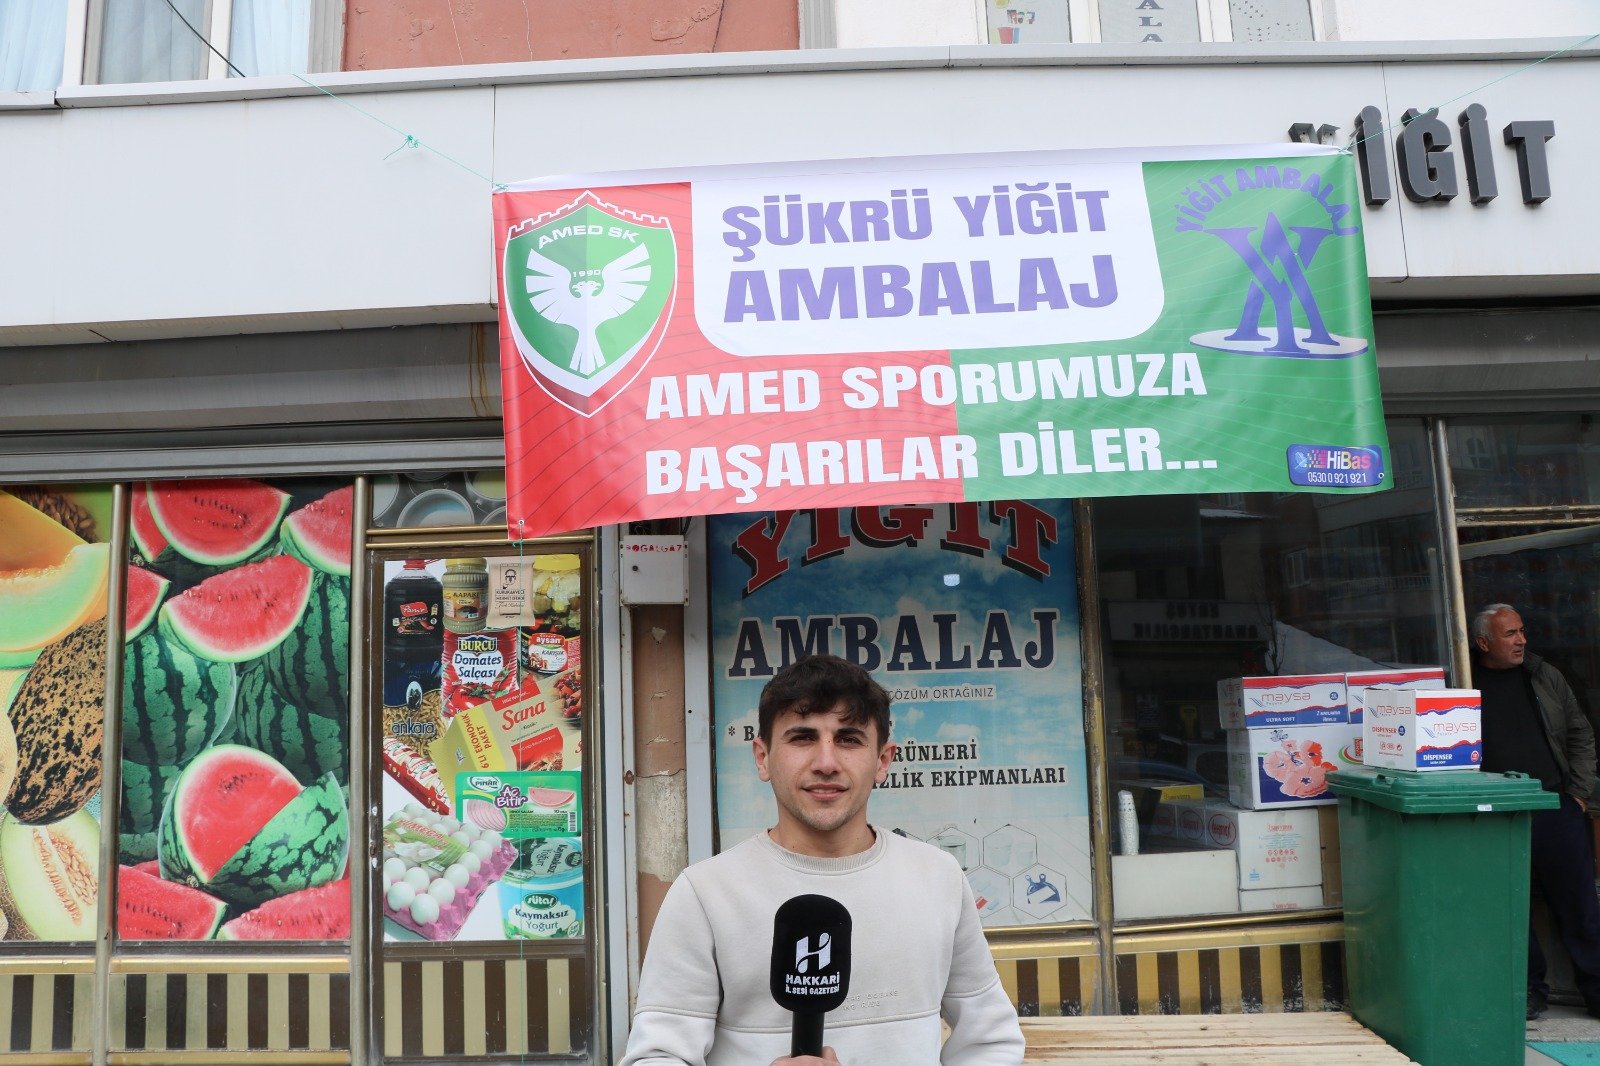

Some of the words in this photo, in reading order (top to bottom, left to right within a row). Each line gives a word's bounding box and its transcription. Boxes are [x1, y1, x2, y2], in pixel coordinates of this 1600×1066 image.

[1175, 174, 1233, 233] YİĞİT
[1235, 165, 1359, 236] AMBALAJ
[722, 188, 933, 263] ŞÜKRÜ
[952, 181, 1110, 238] YİĞİT
[538, 225, 603, 250] AMED
[608, 226, 640, 244] SK
[572, 269, 602, 278] 1990
[723, 254, 1119, 323] AMBALAJ
[645, 369, 821, 420] AMED
[841, 352, 1207, 409] SPORUMUZA
[645, 434, 979, 504] BAŞARILAR
[999, 421, 1218, 477] DİLER...
[1327, 450, 1372, 470] HiBas
[460, 640, 495, 651] BURCU
[536, 635, 562, 644] aysan
[728, 610, 1057, 678] AMBALAJ
[454, 653, 502, 666] Domates
[458, 666, 497, 680] Salçası
[933, 686, 994, 698] ORTAĞINIZ
[1261, 692, 1311, 703] maysa
[502, 700, 547, 731] Sana
[1376, 704, 1412, 716] maysa
[391, 716, 435, 735] ankara
[1433, 722, 1477, 734] maysa
[476, 725, 492, 749] PAKET
[890, 739, 977, 763] RÜNLERİ
[931, 766, 1066, 788] EKİPMANLARI
[527, 895, 555, 907] sütaş
[515, 908, 569, 920] Kaymaksız
[525, 921, 559, 932] Yoğurt
[785, 971, 840, 986] HAKKARİ
[792, 986, 808, 995] SESİ
[809, 984, 840, 995] GAZETESİ
